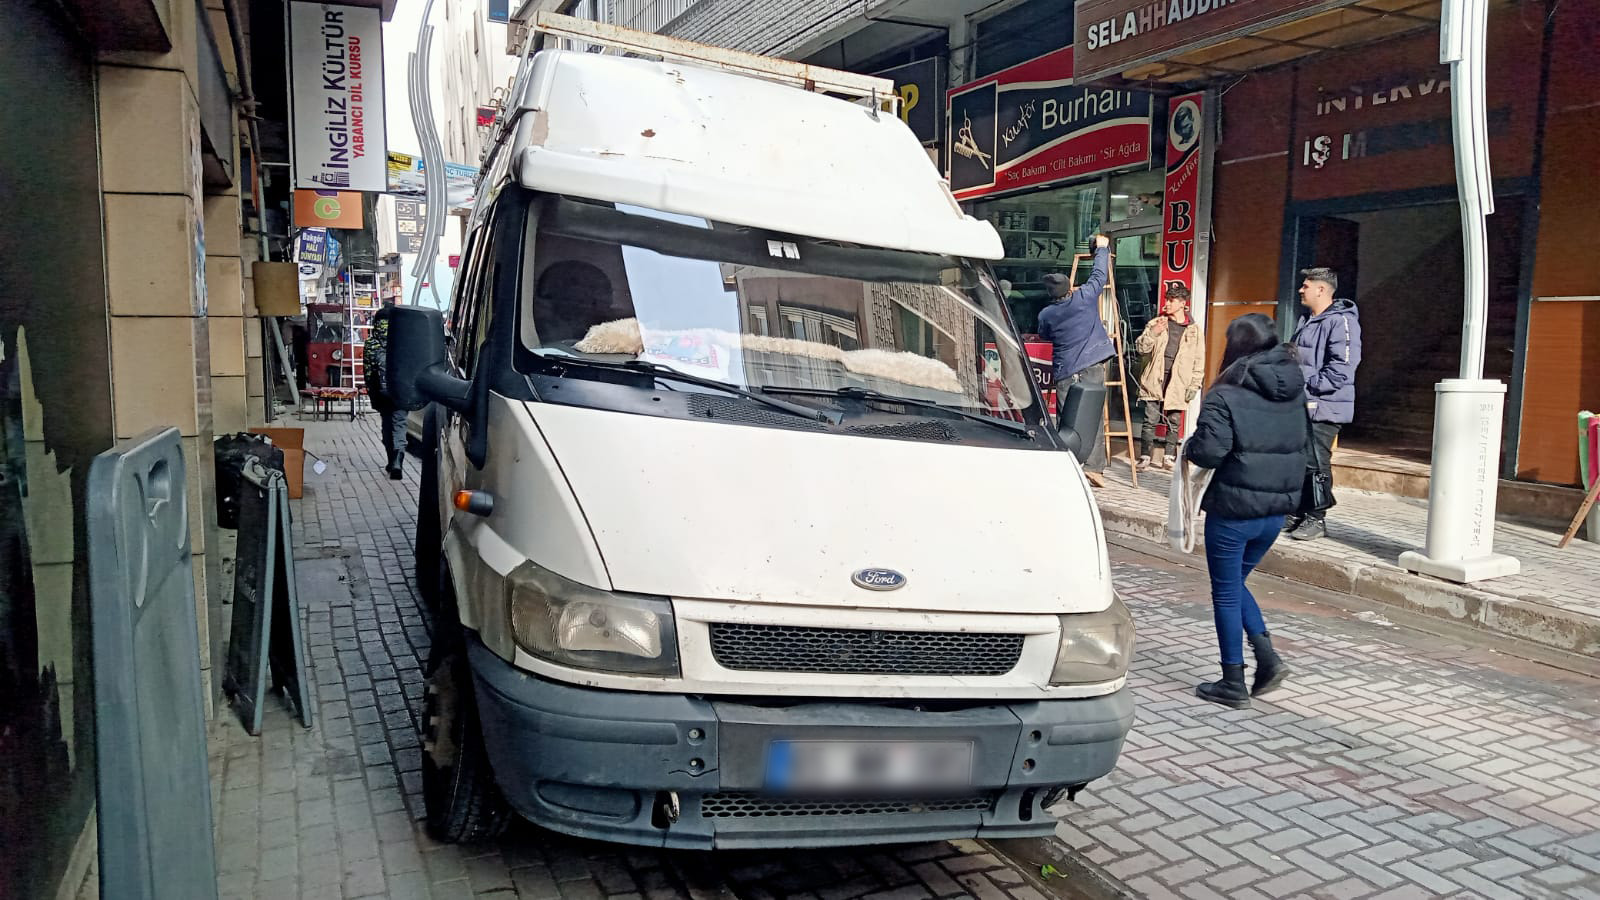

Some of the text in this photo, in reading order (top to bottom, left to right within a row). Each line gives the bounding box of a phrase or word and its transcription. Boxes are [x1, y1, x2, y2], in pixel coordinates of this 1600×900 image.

[1087, 0, 1236, 51] SELAHHADD
[321, 10, 349, 169] İNGİLİZ KÜLTÜR
[348, 36, 365, 159] YABANCI DİL KURSU
[1042, 88, 1131, 130] Burhan
[1022, 164, 1047, 178] Bakımı
[1068, 153, 1096, 167] Bakımı
[865, 571, 896, 584] Ford
